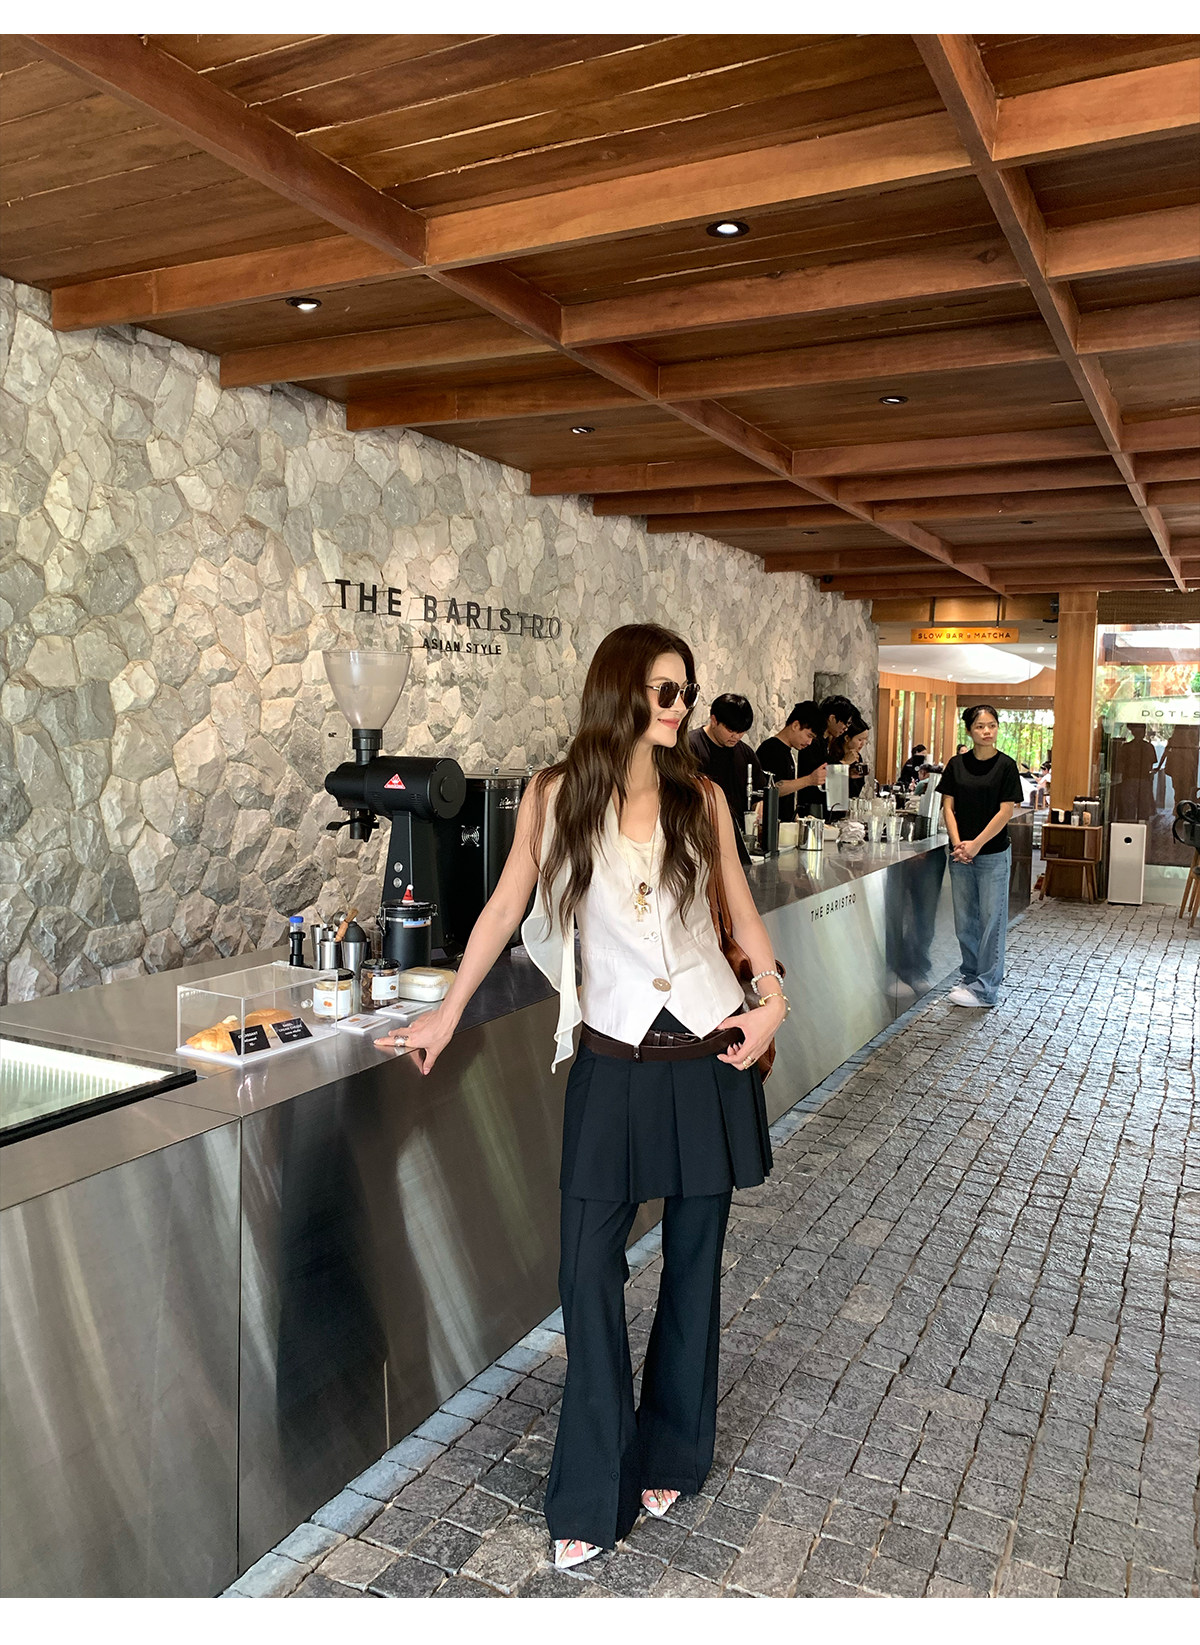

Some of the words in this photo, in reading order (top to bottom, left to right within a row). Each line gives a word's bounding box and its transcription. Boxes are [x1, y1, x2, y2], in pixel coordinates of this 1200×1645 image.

[335, 578, 401, 616] THE
[424, 594, 561, 639] BARISTRO
[423, 638, 460, 652] ASIAN
[466, 643, 501, 655] STYLE
[811, 906, 823, 922] THE
[826, 893, 856, 915] BARISTRO
